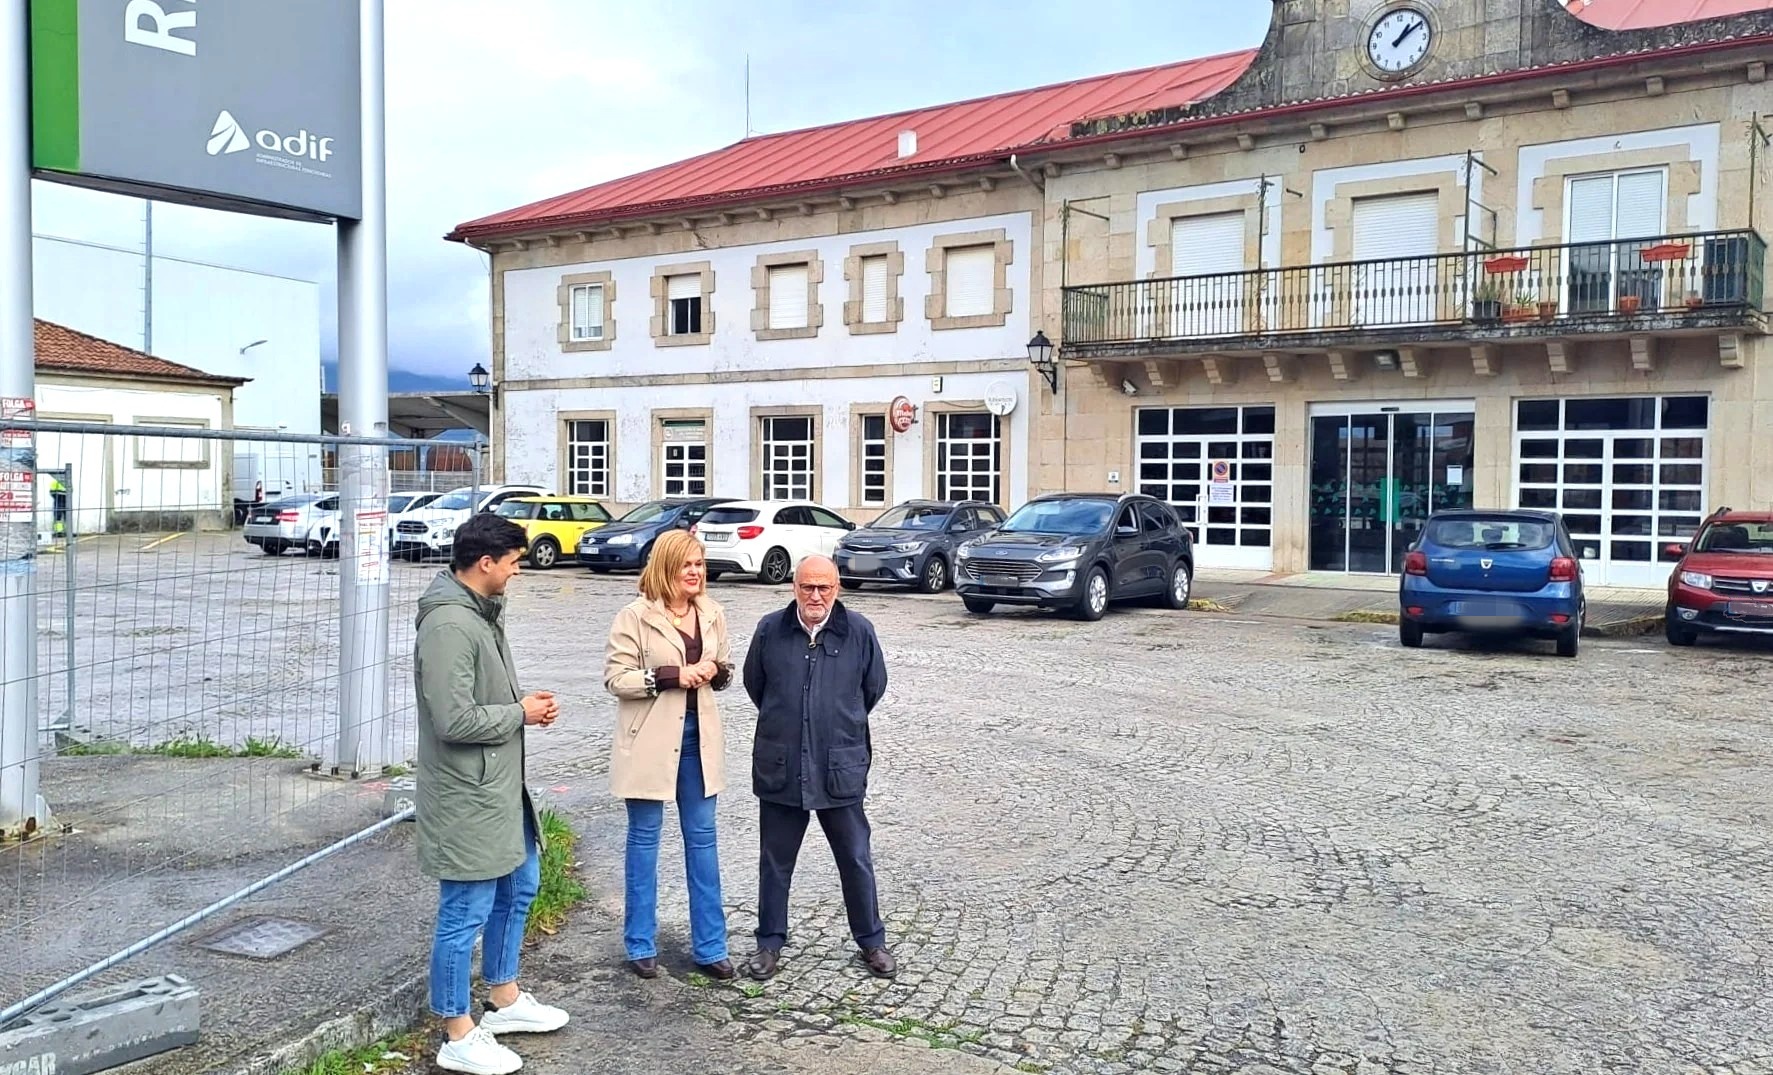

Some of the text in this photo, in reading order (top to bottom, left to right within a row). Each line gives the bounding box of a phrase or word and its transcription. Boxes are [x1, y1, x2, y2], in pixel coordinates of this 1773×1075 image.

[125, 0, 196, 57] R
[255, 129, 335, 162] adif
[2, 399, 25, 409] FOLGA
[0, 472, 24, 482] FOLGA
